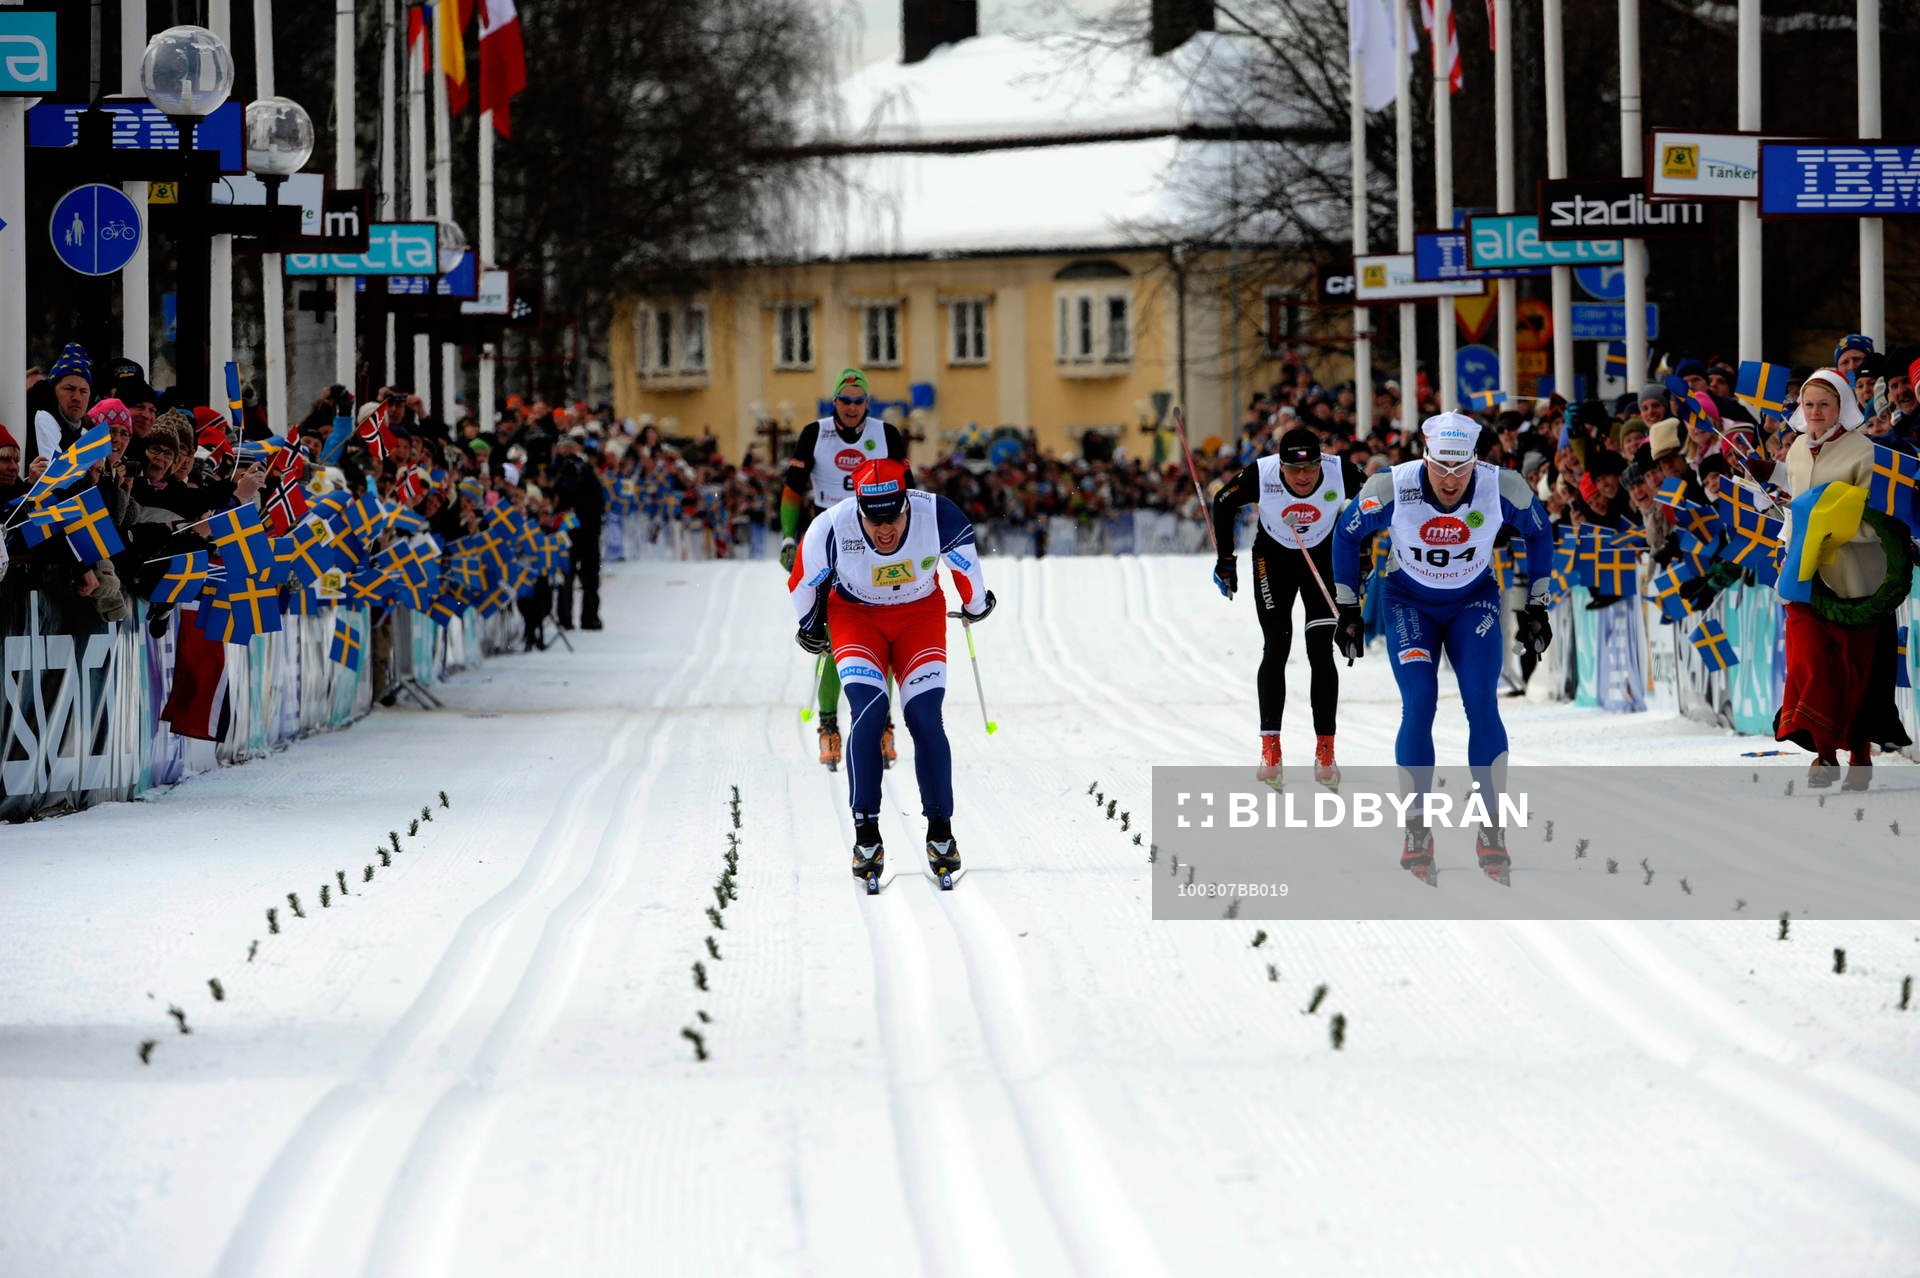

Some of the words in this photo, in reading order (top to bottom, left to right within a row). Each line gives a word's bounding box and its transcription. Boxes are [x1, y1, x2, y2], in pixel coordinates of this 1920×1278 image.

[1796, 149, 1920, 207] IBM
[1550, 193, 1703, 226] stadium
[1426, 524, 1463, 539] mix
